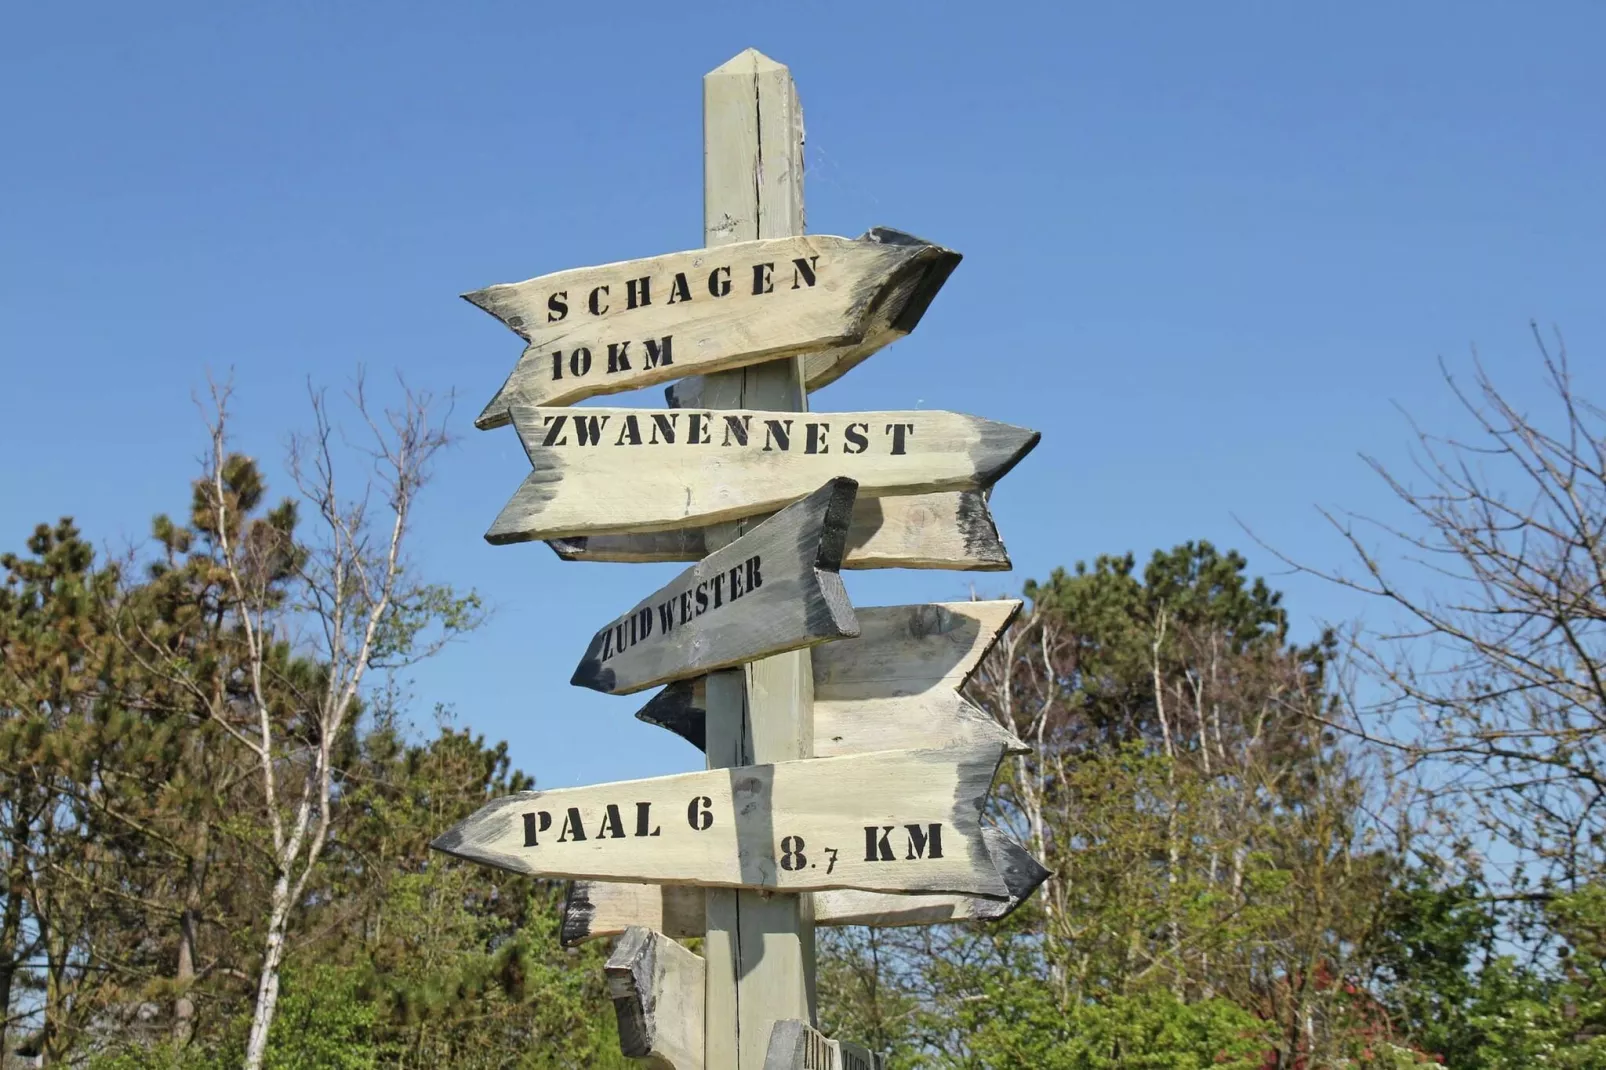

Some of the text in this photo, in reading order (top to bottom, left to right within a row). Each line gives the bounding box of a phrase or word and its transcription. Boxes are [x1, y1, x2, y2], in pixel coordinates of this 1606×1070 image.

[547, 256, 821, 322] SCHAGEN
[542, 414, 914, 456] ZWANENNEST
[522, 797, 714, 848] PAAL 6
[780, 824, 944, 875] 8.7 KM
